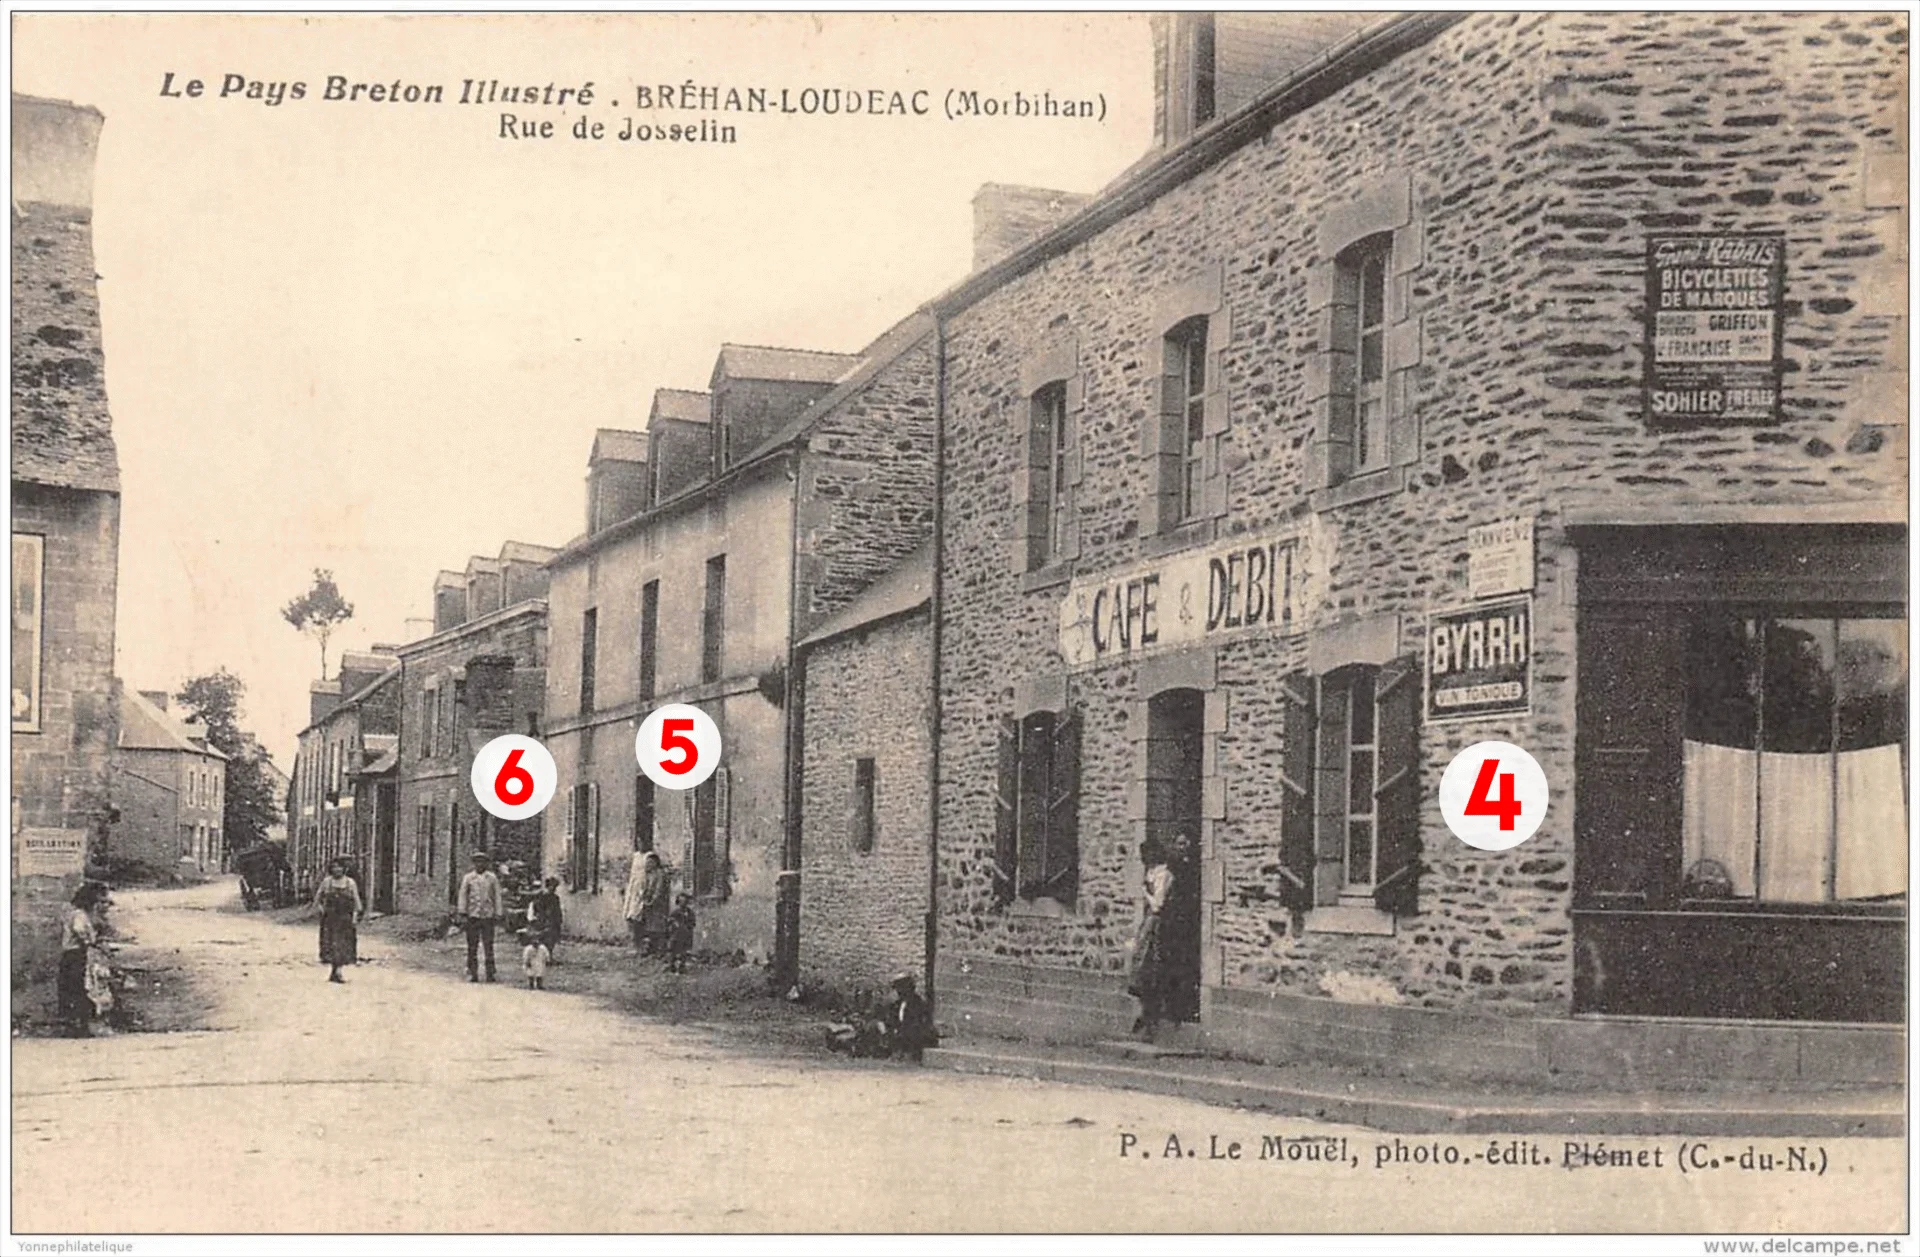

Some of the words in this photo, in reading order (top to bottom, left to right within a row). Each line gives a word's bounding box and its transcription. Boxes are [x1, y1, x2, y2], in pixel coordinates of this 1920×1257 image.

[1661, 268, 1769, 290] BICYCLETTES
[1661, 292, 1682, 308] DE
[1686, 291, 1769, 308] MARQUES
[1709, 313, 1768, 331] GRIFFON
[1652, 390, 1722, 412] SOHIER
[1092, 572, 1160, 653] CAFE
[1206, 536, 1300, 632] DEBIT
[1432, 612, 1526, 675] BYRRH
